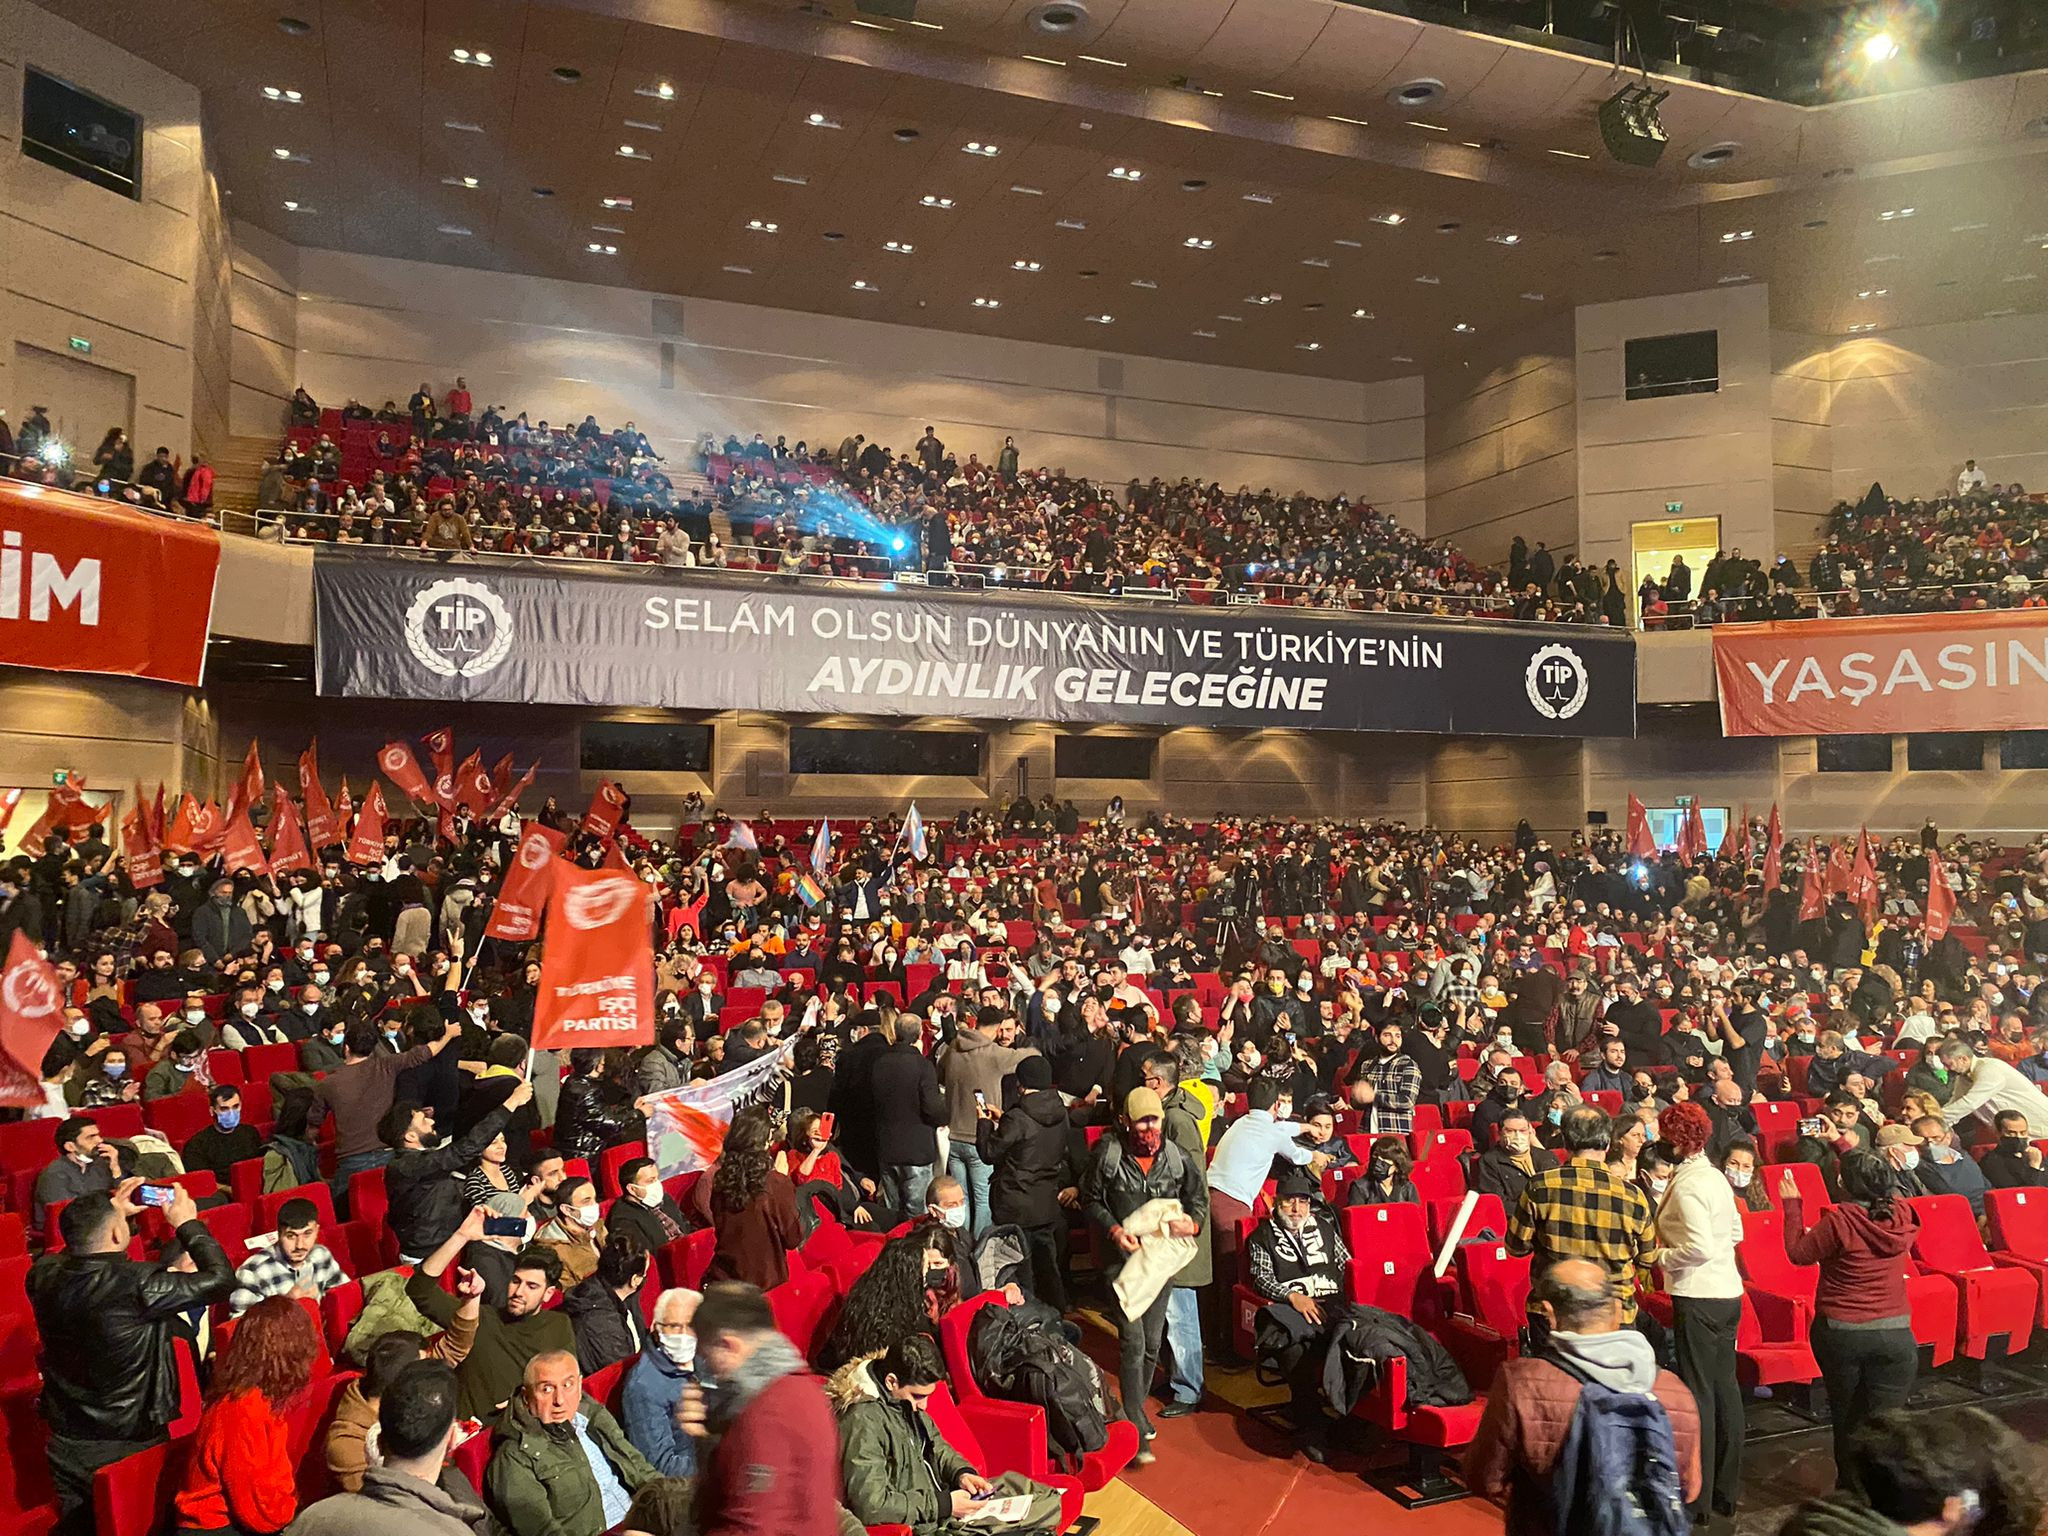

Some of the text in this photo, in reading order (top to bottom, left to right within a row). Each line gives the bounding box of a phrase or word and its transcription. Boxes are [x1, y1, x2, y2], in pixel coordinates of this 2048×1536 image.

[0, 530, 101, 626] İM
[435, 601, 486, 631] TİP
[644, 596, 795, 637] SELAM
[811, 607, 951, 645] OLSUN
[967, 611, 1164, 656] DÜNYANIN
[1176, 629, 1223, 659] VE
[806, 656, 1328, 711] AYDINLIK GELECEĞİNE
[1543, 661, 1573, 684] TİP
[1746, 638, 2048, 707] YAŞASIN
[563, 1013, 638, 1032] PARTİSİ
